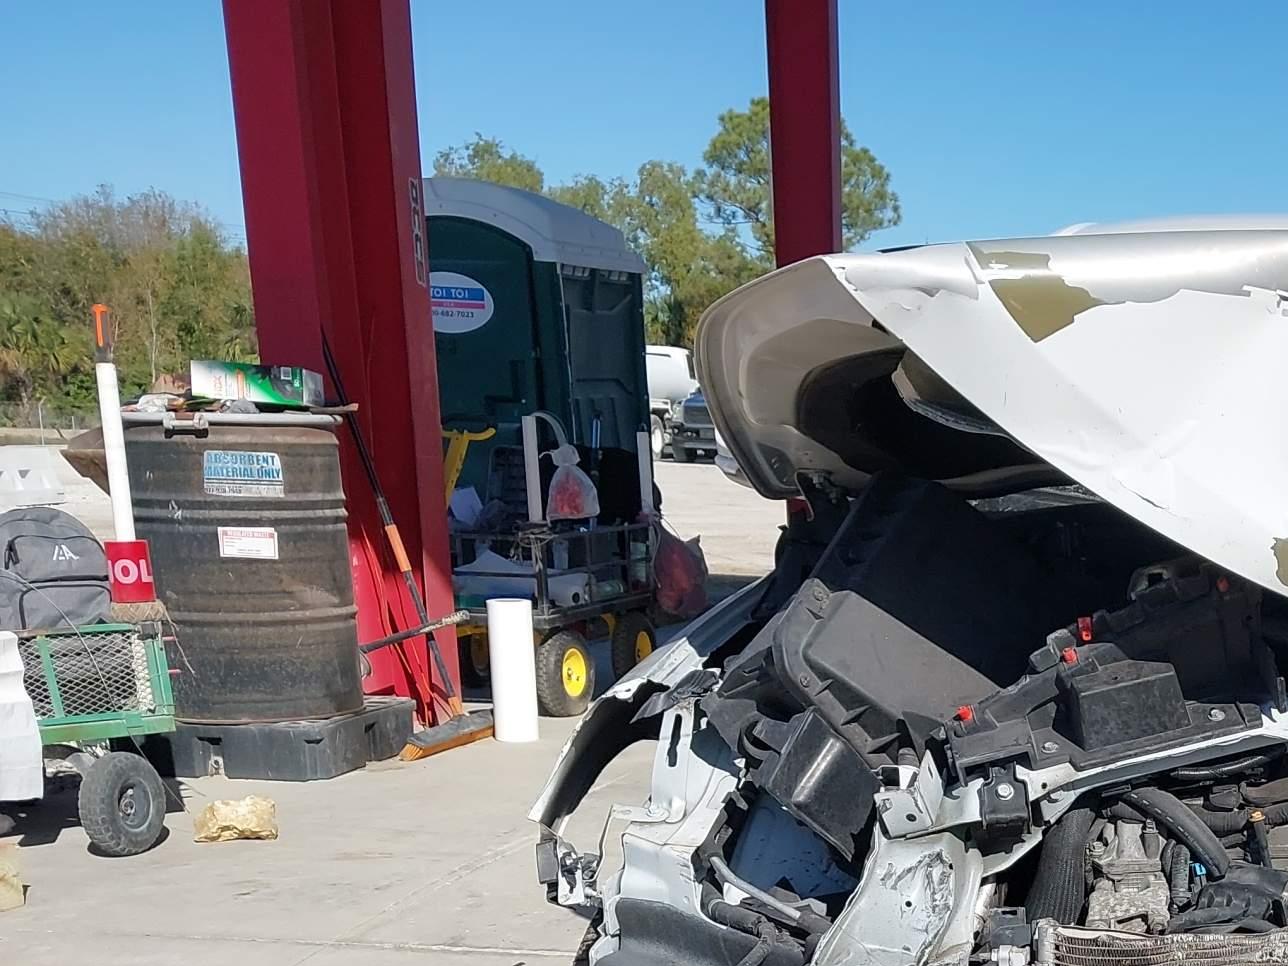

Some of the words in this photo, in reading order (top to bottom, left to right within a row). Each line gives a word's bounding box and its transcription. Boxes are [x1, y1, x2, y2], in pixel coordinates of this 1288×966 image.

[450, 288, 469, 298] TOI
[207, 453, 276, 466] ABSORBENT
[205, 465, 255, 478] MATERIAL
[256, 466, 281, 479] ONLY
